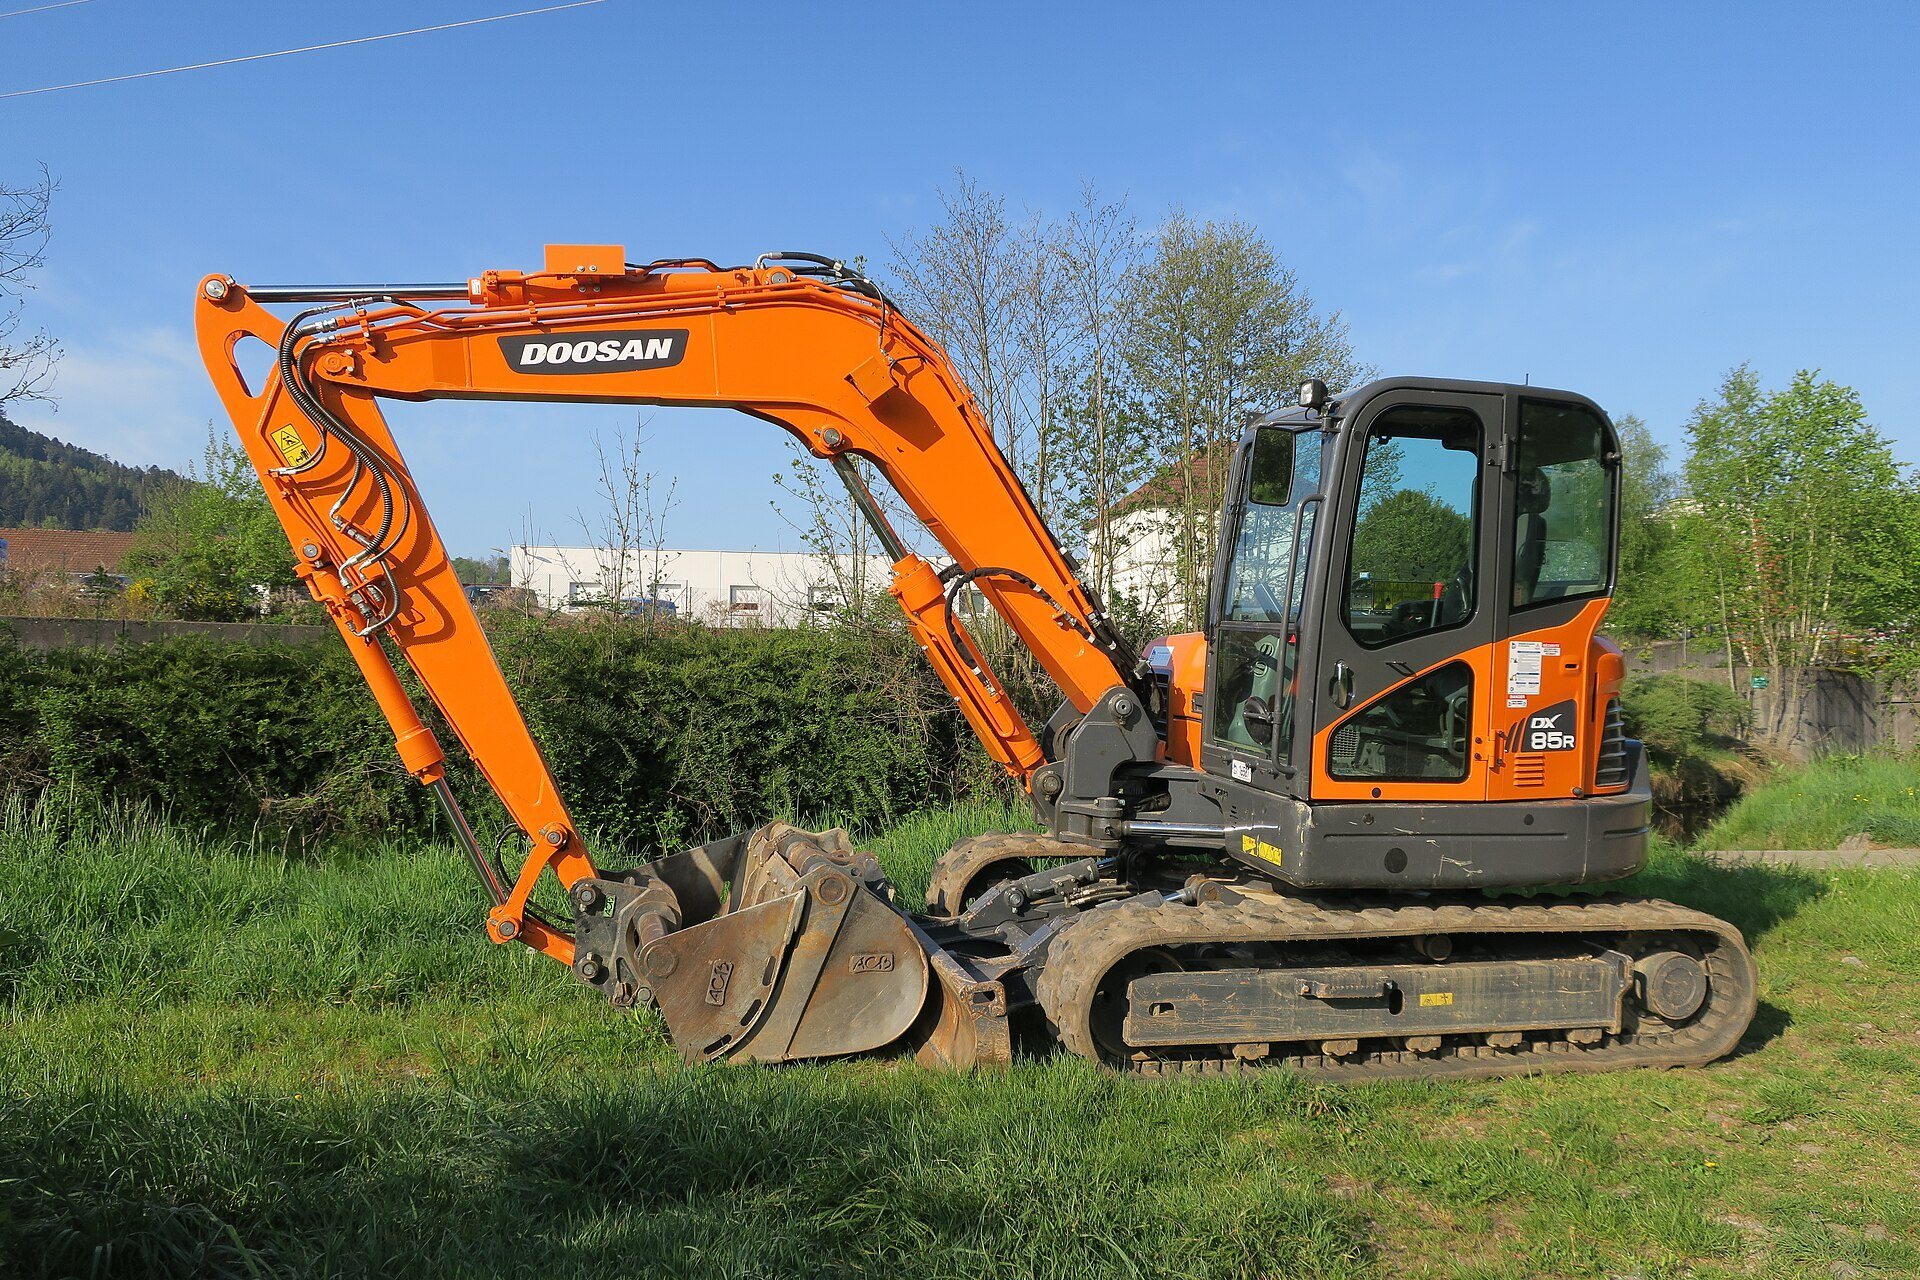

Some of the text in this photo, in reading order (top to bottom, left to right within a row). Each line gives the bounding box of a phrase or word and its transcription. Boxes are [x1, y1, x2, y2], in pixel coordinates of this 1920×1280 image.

[519, 338, 673, 366] DOOSAN
[1531, 713, 1562, 729] DX
[1531, 731, 1575, 750] 85R
